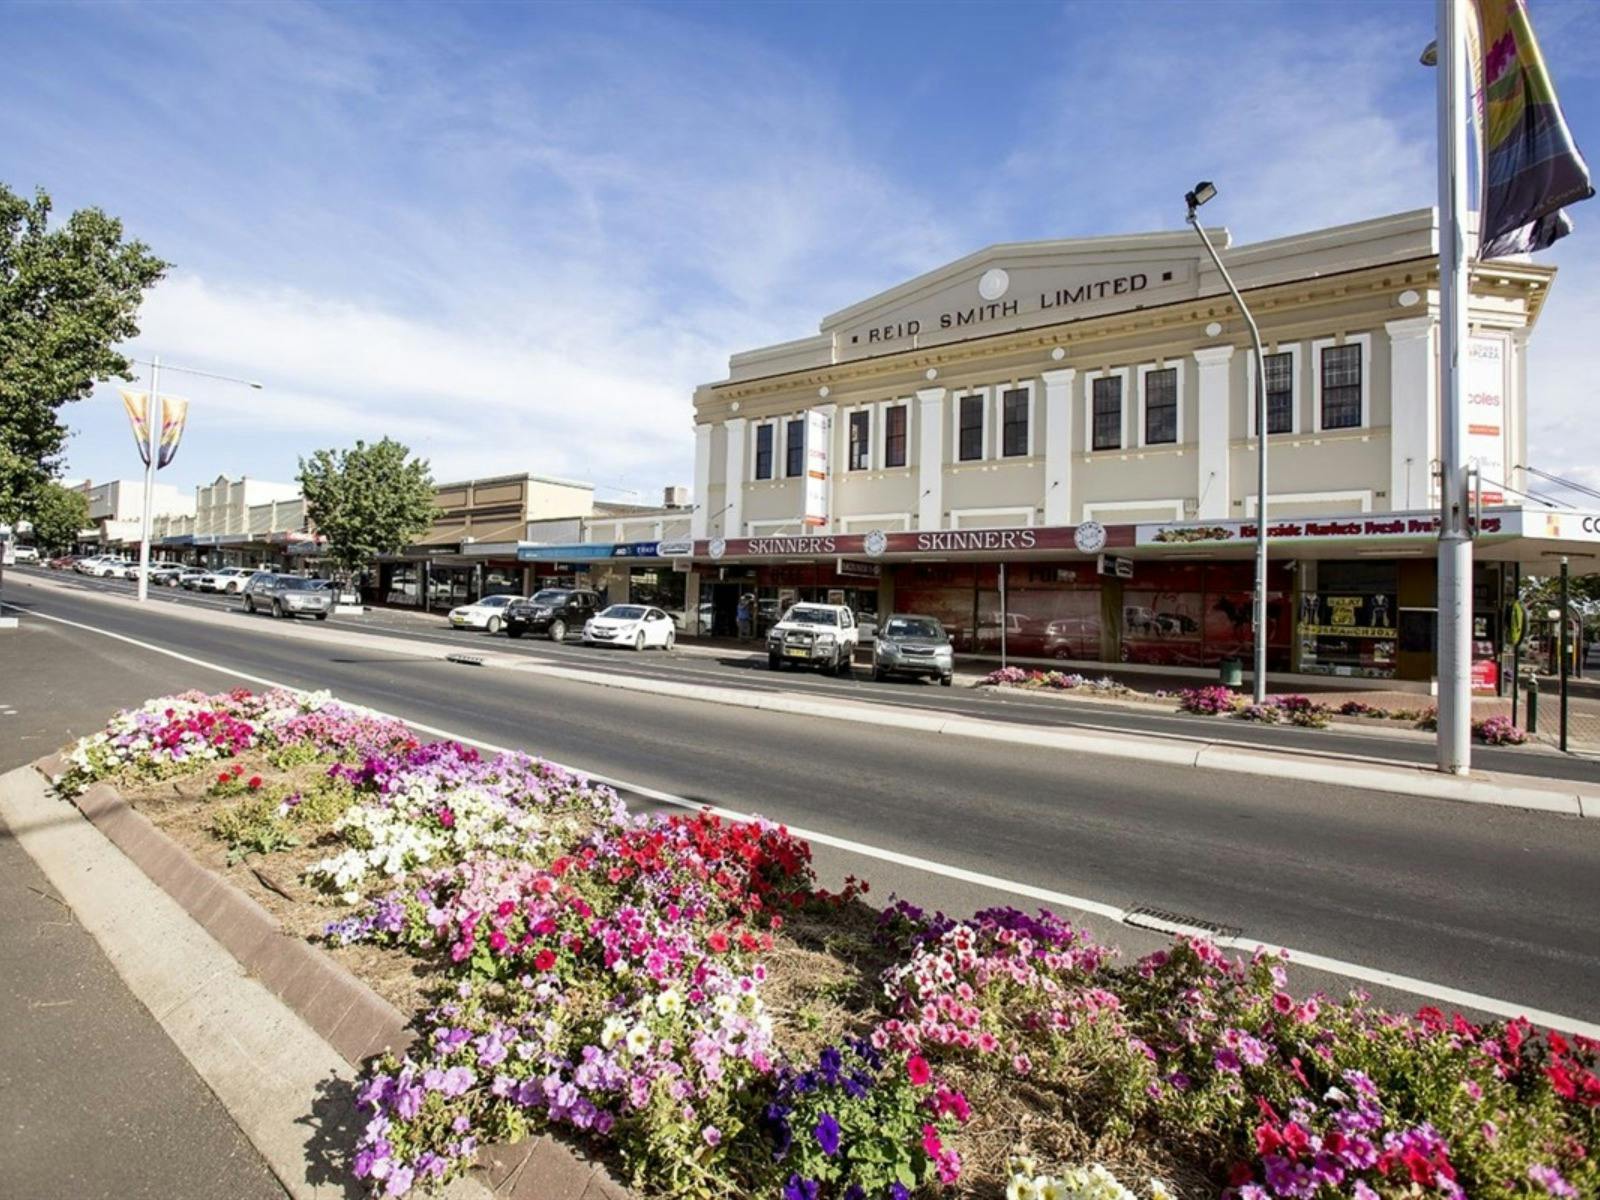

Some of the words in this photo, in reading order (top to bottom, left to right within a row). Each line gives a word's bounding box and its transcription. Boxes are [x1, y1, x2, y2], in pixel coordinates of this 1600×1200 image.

[868, 320, 921, 343] REID
[940, 300, 1019, 329] SMITH
[1041, 273, 1148, 309] LIMITED
[748, 537, 836, 554] SKINNER'S
[917, 530, 1037, 550] SKINNER'S
